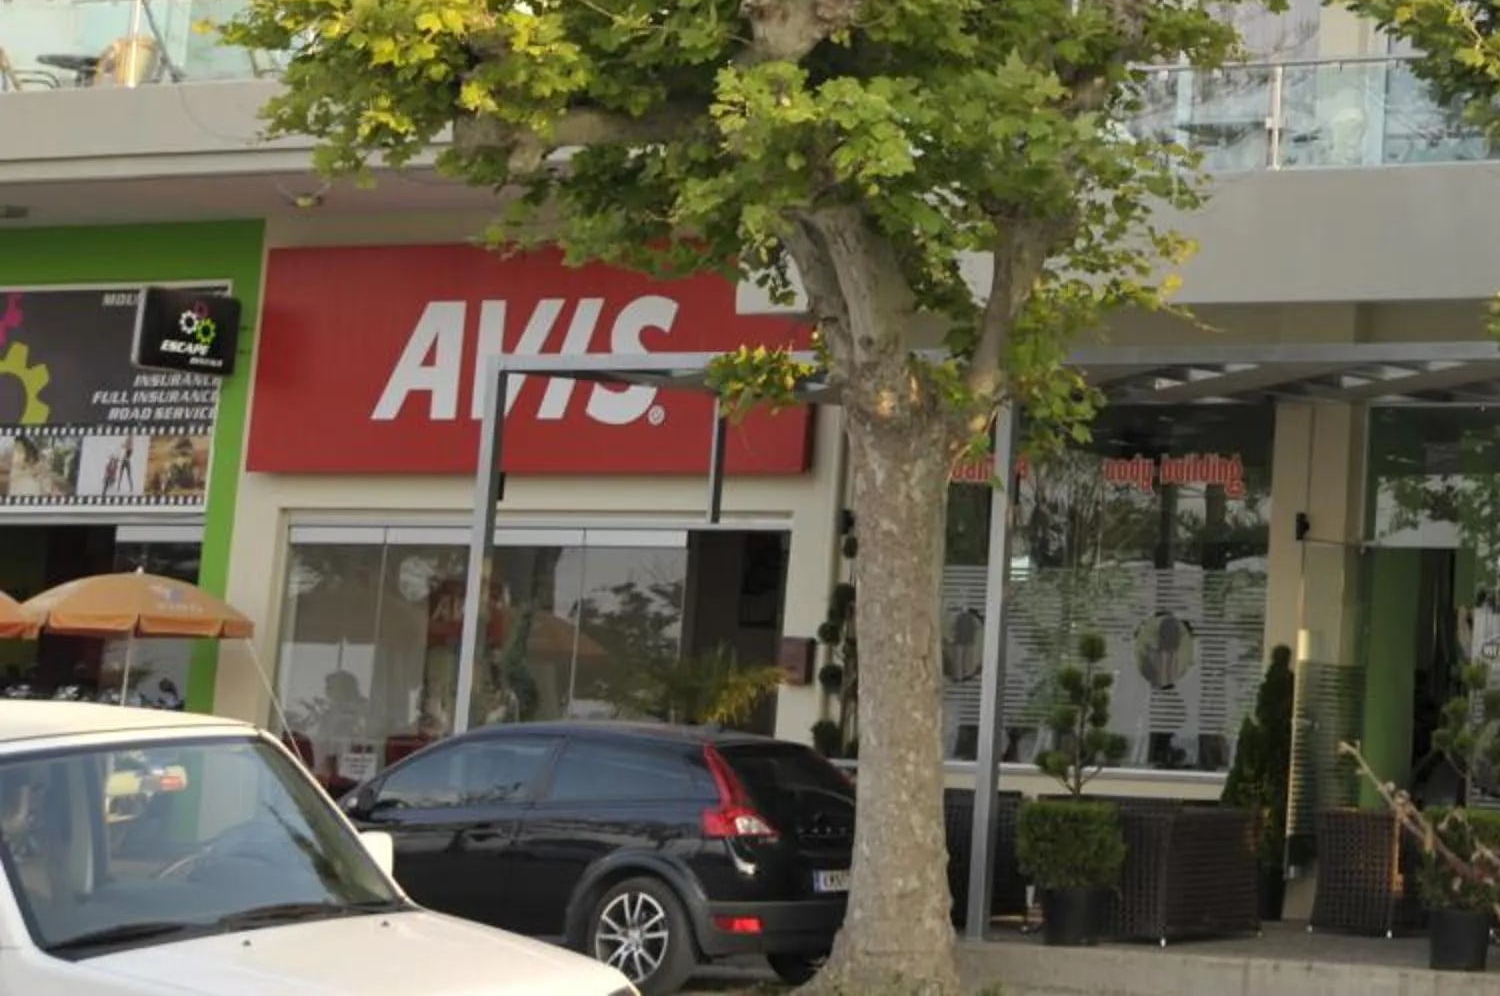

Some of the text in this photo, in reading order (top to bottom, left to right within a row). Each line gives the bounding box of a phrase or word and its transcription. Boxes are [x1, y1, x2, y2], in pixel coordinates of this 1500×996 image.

[160, 339, 210, 356] ESCAPE
[371, 295, 679, 425] AVIS
[133, 374, 219, 387] INSURANCE
[92, 390, 218, 404] FULL INSURANCE
[107, 406, 217, 420] ROAD SERVICE
[1160, 453, 1245, 500] building
